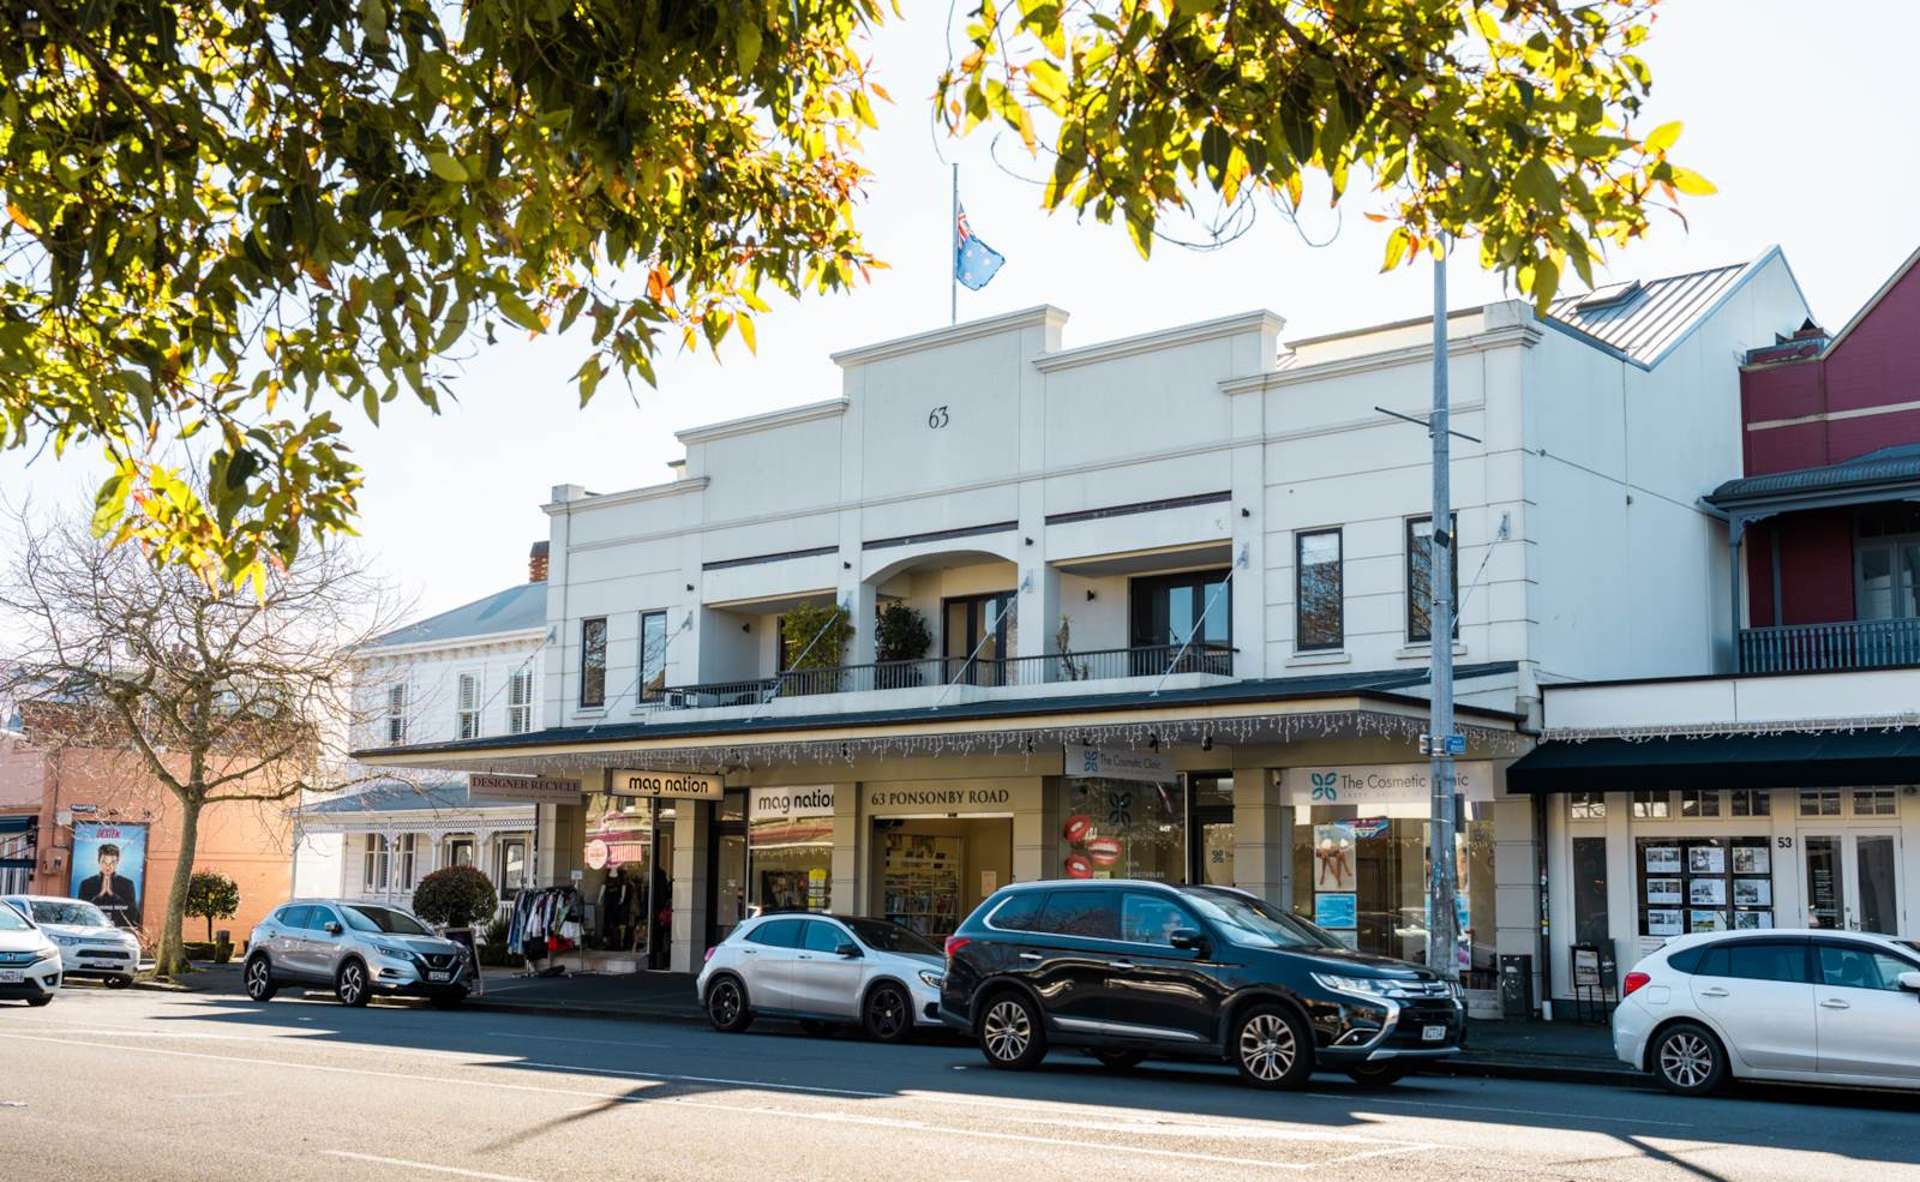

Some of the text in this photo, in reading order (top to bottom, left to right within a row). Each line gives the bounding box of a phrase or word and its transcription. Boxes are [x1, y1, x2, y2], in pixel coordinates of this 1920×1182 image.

[929, 405, 949, 429] 63
[472, 776, 578, 792] DESIGNER RECYCLE
[629, 776, 708, 795] mag nation
[1341, 772, 1427, 789] The Cosmetic
[759, 796, 790, 814] mag
[871, 788, 1009, 806] 63 PONSONBY ROAD
[1777, 836, 1793, 848] 53
